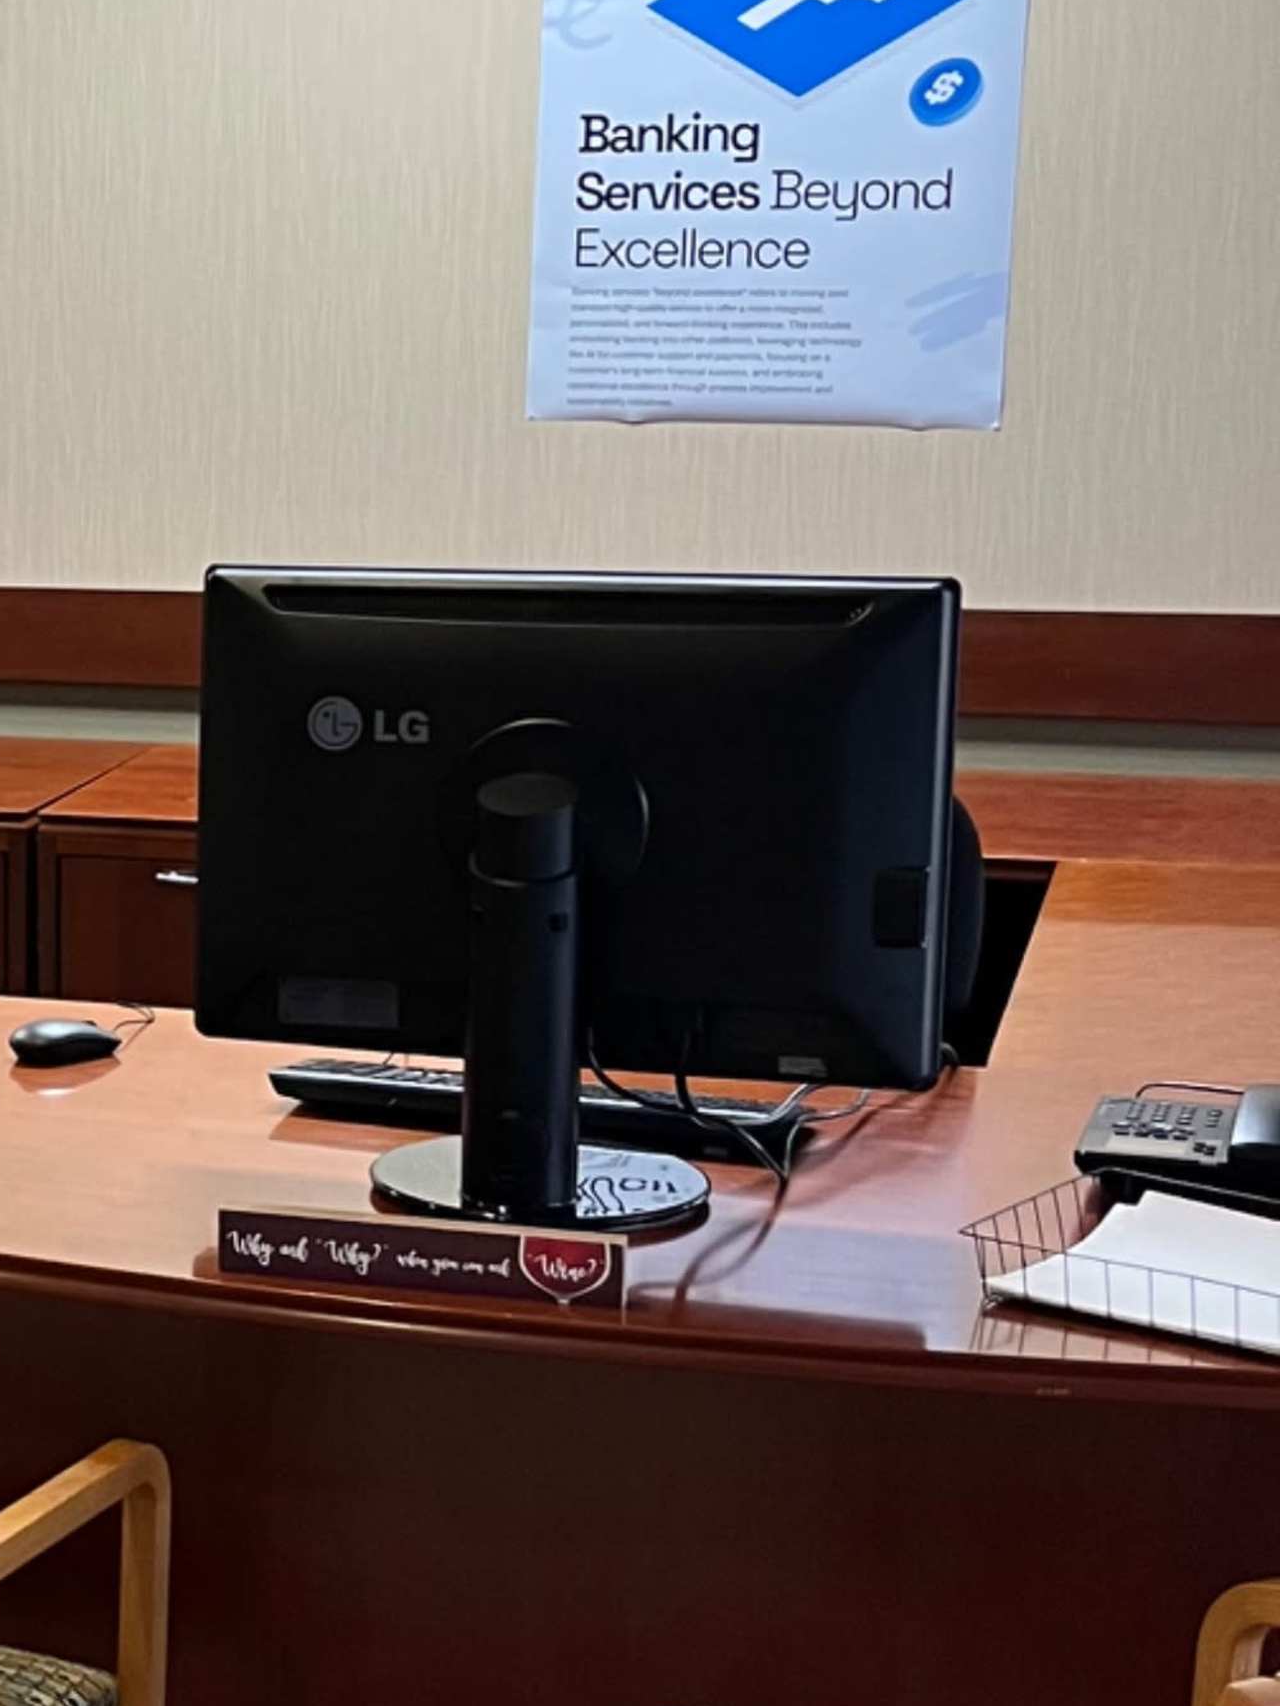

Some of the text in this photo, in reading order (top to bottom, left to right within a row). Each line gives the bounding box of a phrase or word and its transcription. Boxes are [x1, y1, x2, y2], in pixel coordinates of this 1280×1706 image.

[578, 111, 760, 163] Banking
[575, 167, 953, 222] Services Beyond
[574, 227, 811, 270] Excellence
[375, 709, 429, 744] LG
